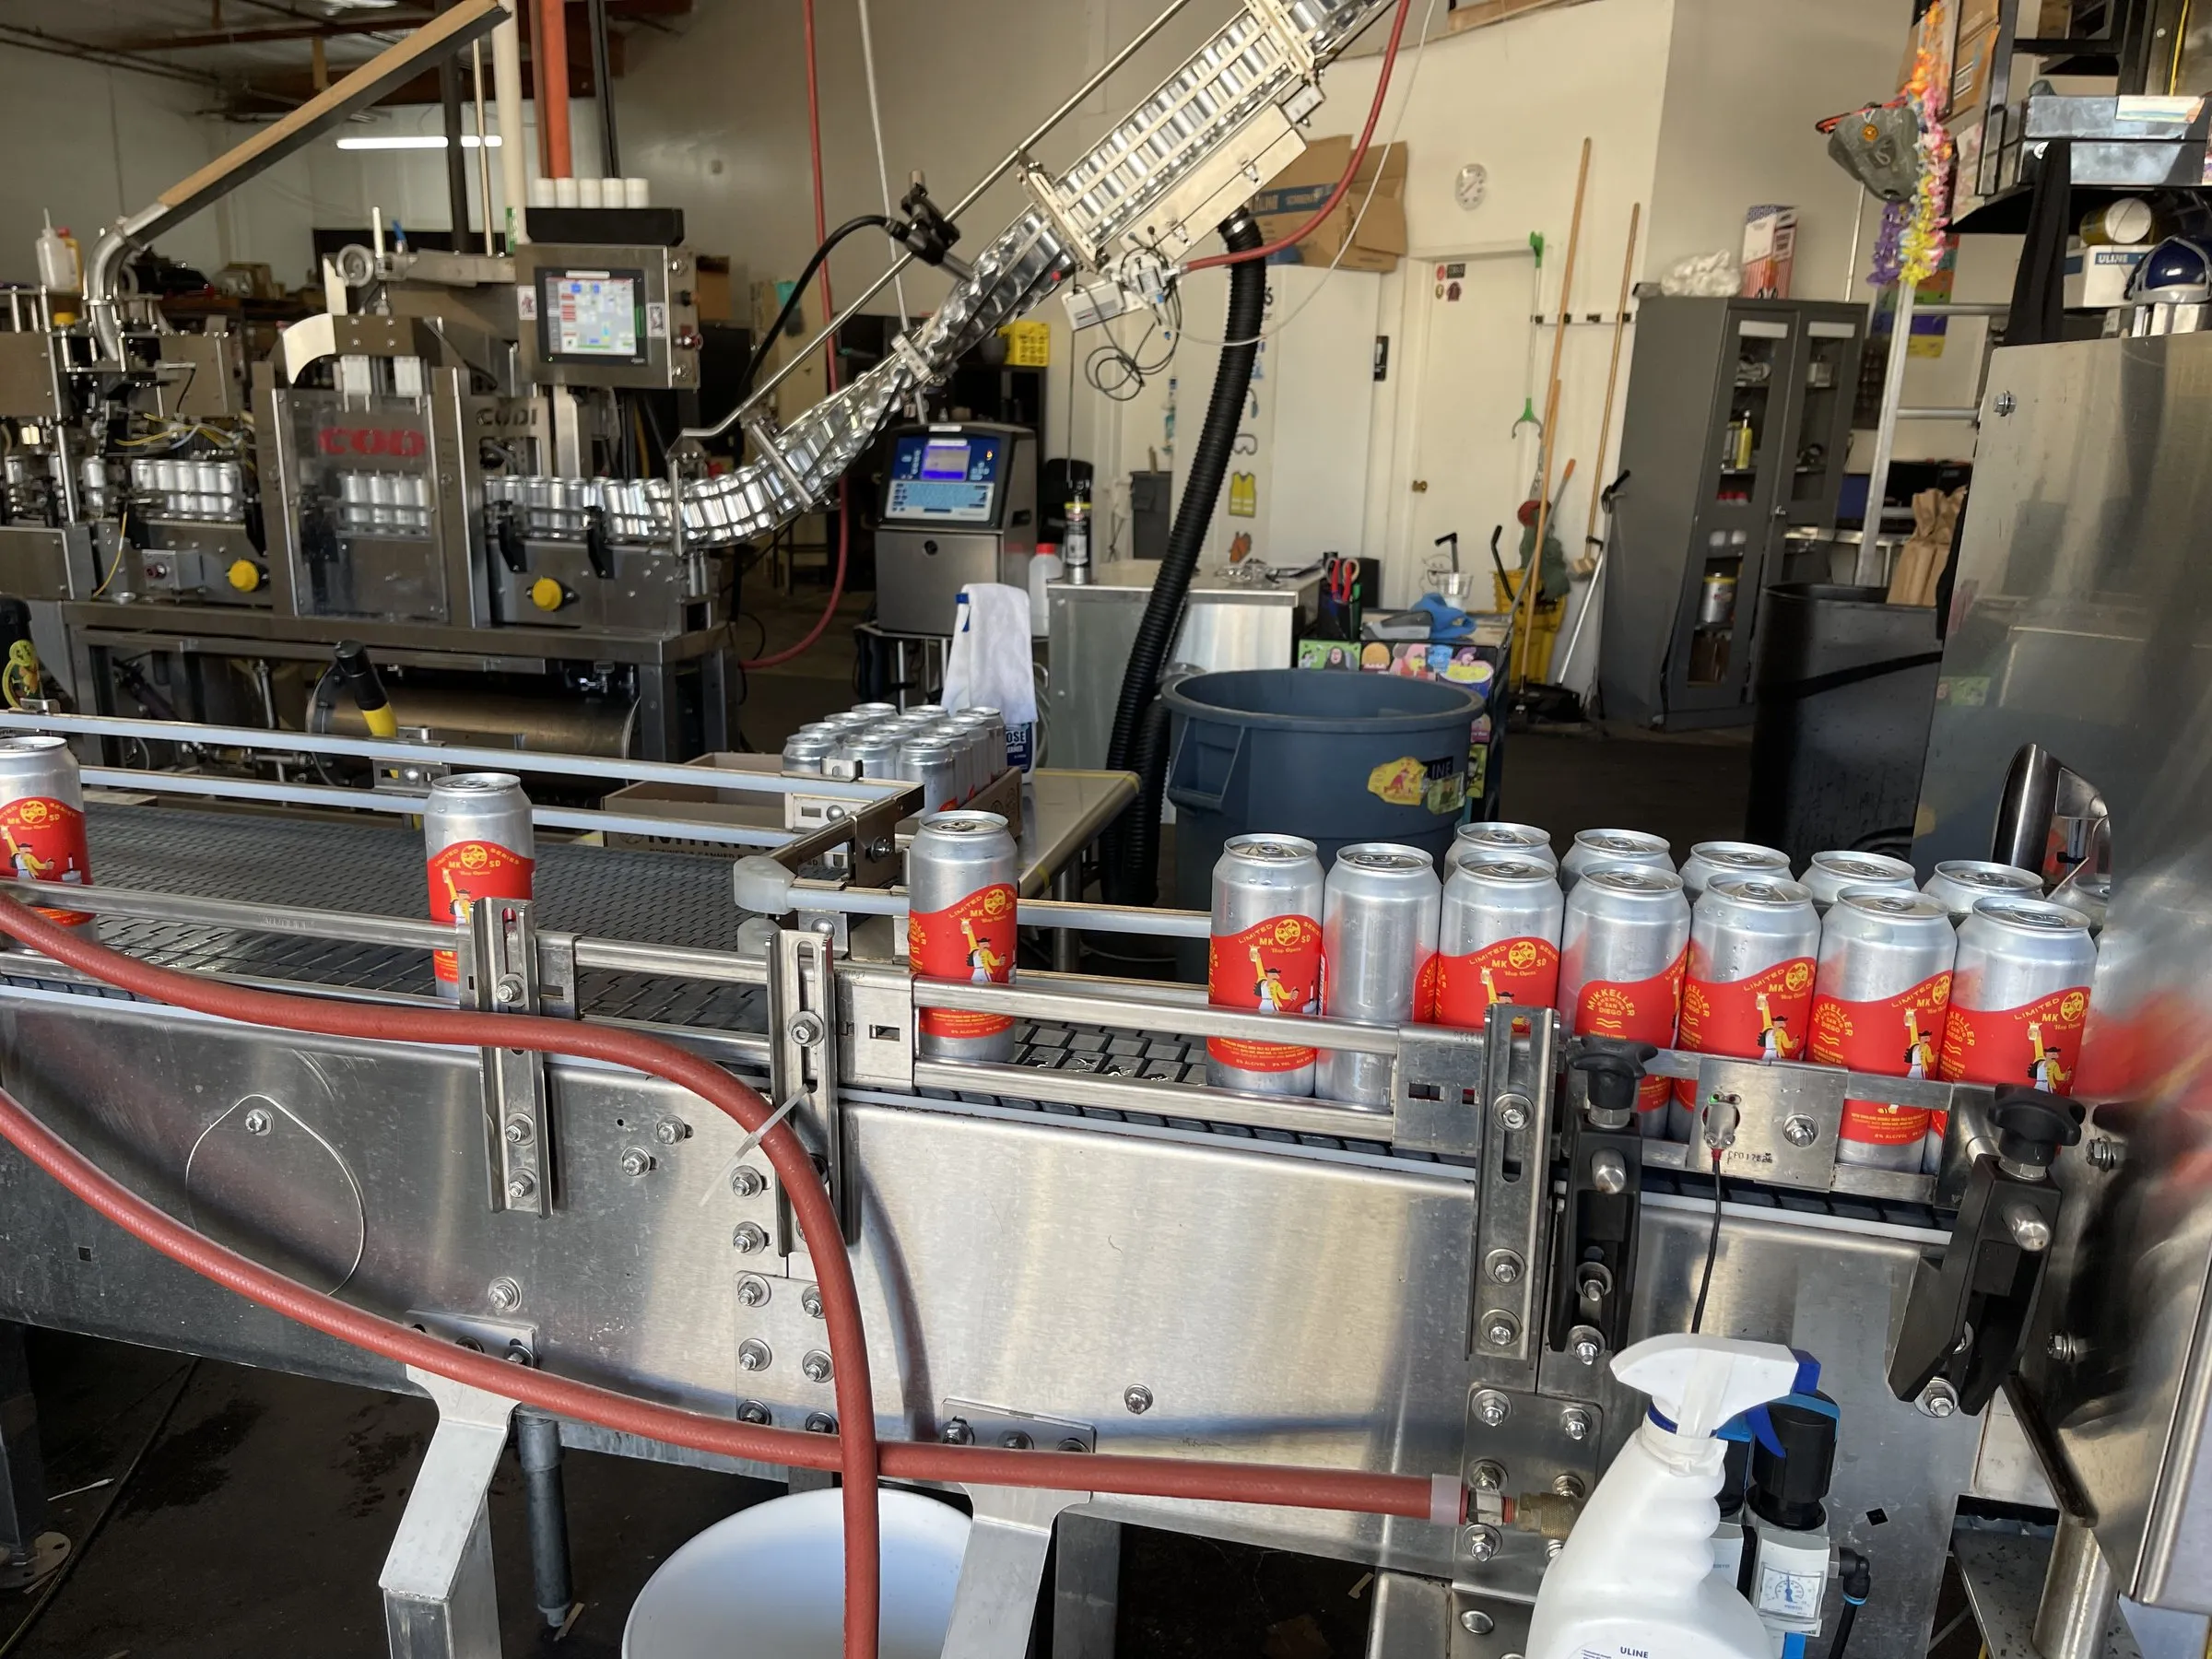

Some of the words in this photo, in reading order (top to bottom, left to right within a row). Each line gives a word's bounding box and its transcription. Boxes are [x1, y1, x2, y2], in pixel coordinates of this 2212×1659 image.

[2098, 253, 2128, 264] ULINE
[1431, 761, 1452, 779] INE
[6, 818, 21, 826] MK
[434, 848, 460, 867] LIMITED
[489, 847, 520, 865] SERIES
[448, 861, 462, 869] MK
[488, 859, 501, 868] SD
[947, 895, 982, 919] LIMITED
[970, 909, 984, 918] MK
[1238, 924, 1274, 944] LIMITED
[1259, 937, 1274, 947] MK
[1300, 935, 1312, 944] SD
[1468, 945, 1507, 965] LIMITED
[1491, 959, 1508, 968] MK
[1535, 958, 1547, 968] SD
[1743, 969, 1785, 991] LIMITED
[1768, 983, 1784, 993] MK
[1891, 982, 1932, 1007] LIMITED
[1587, 988, 1635, 1017] MIKKELLER
[1916, 998, 1932, 1007] MK
[2014, 997, 2060, 1020] LIMITED
[1599, 1006, 1622, 1016] DIEGO
[1814, 1003, 1853, 1037] MIKKELLER
[1826, 1017, 1837, 1025] SAN
[2041, 1013, 2058, 1022] MK
[1821, 1021, 1841, 1033] DIEGO
[1619, 1646, 1649, 1659] ULINE
